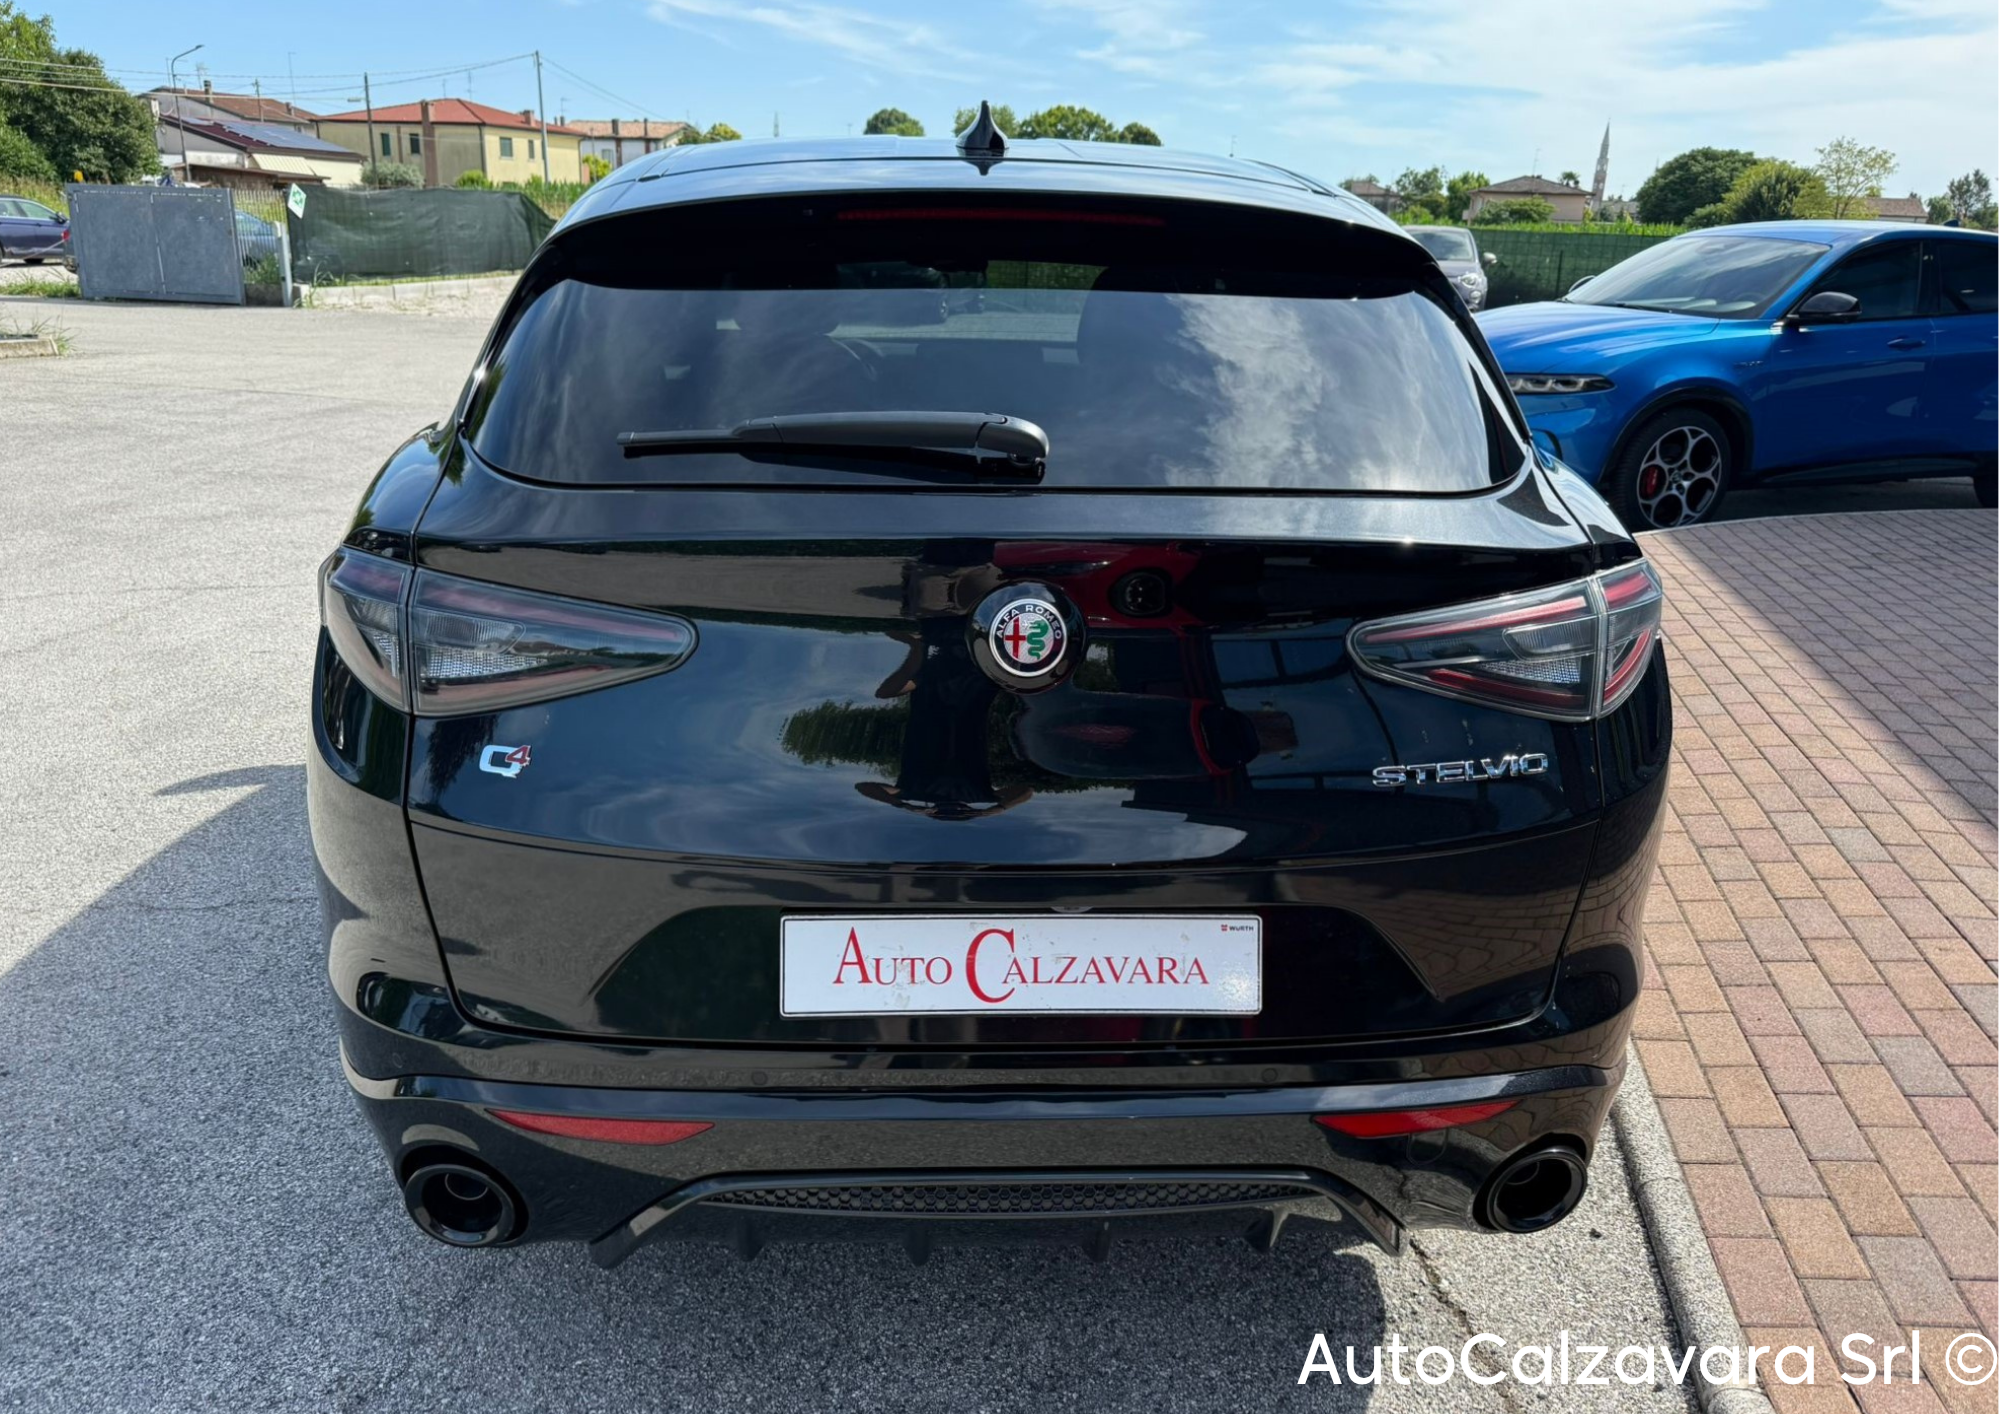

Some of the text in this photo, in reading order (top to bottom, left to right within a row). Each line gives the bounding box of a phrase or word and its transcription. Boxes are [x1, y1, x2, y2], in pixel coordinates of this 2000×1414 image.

[996, 605, 1062, 639] ALFA ROMEO
[1372, 753, 1549, 787] STELVIO
